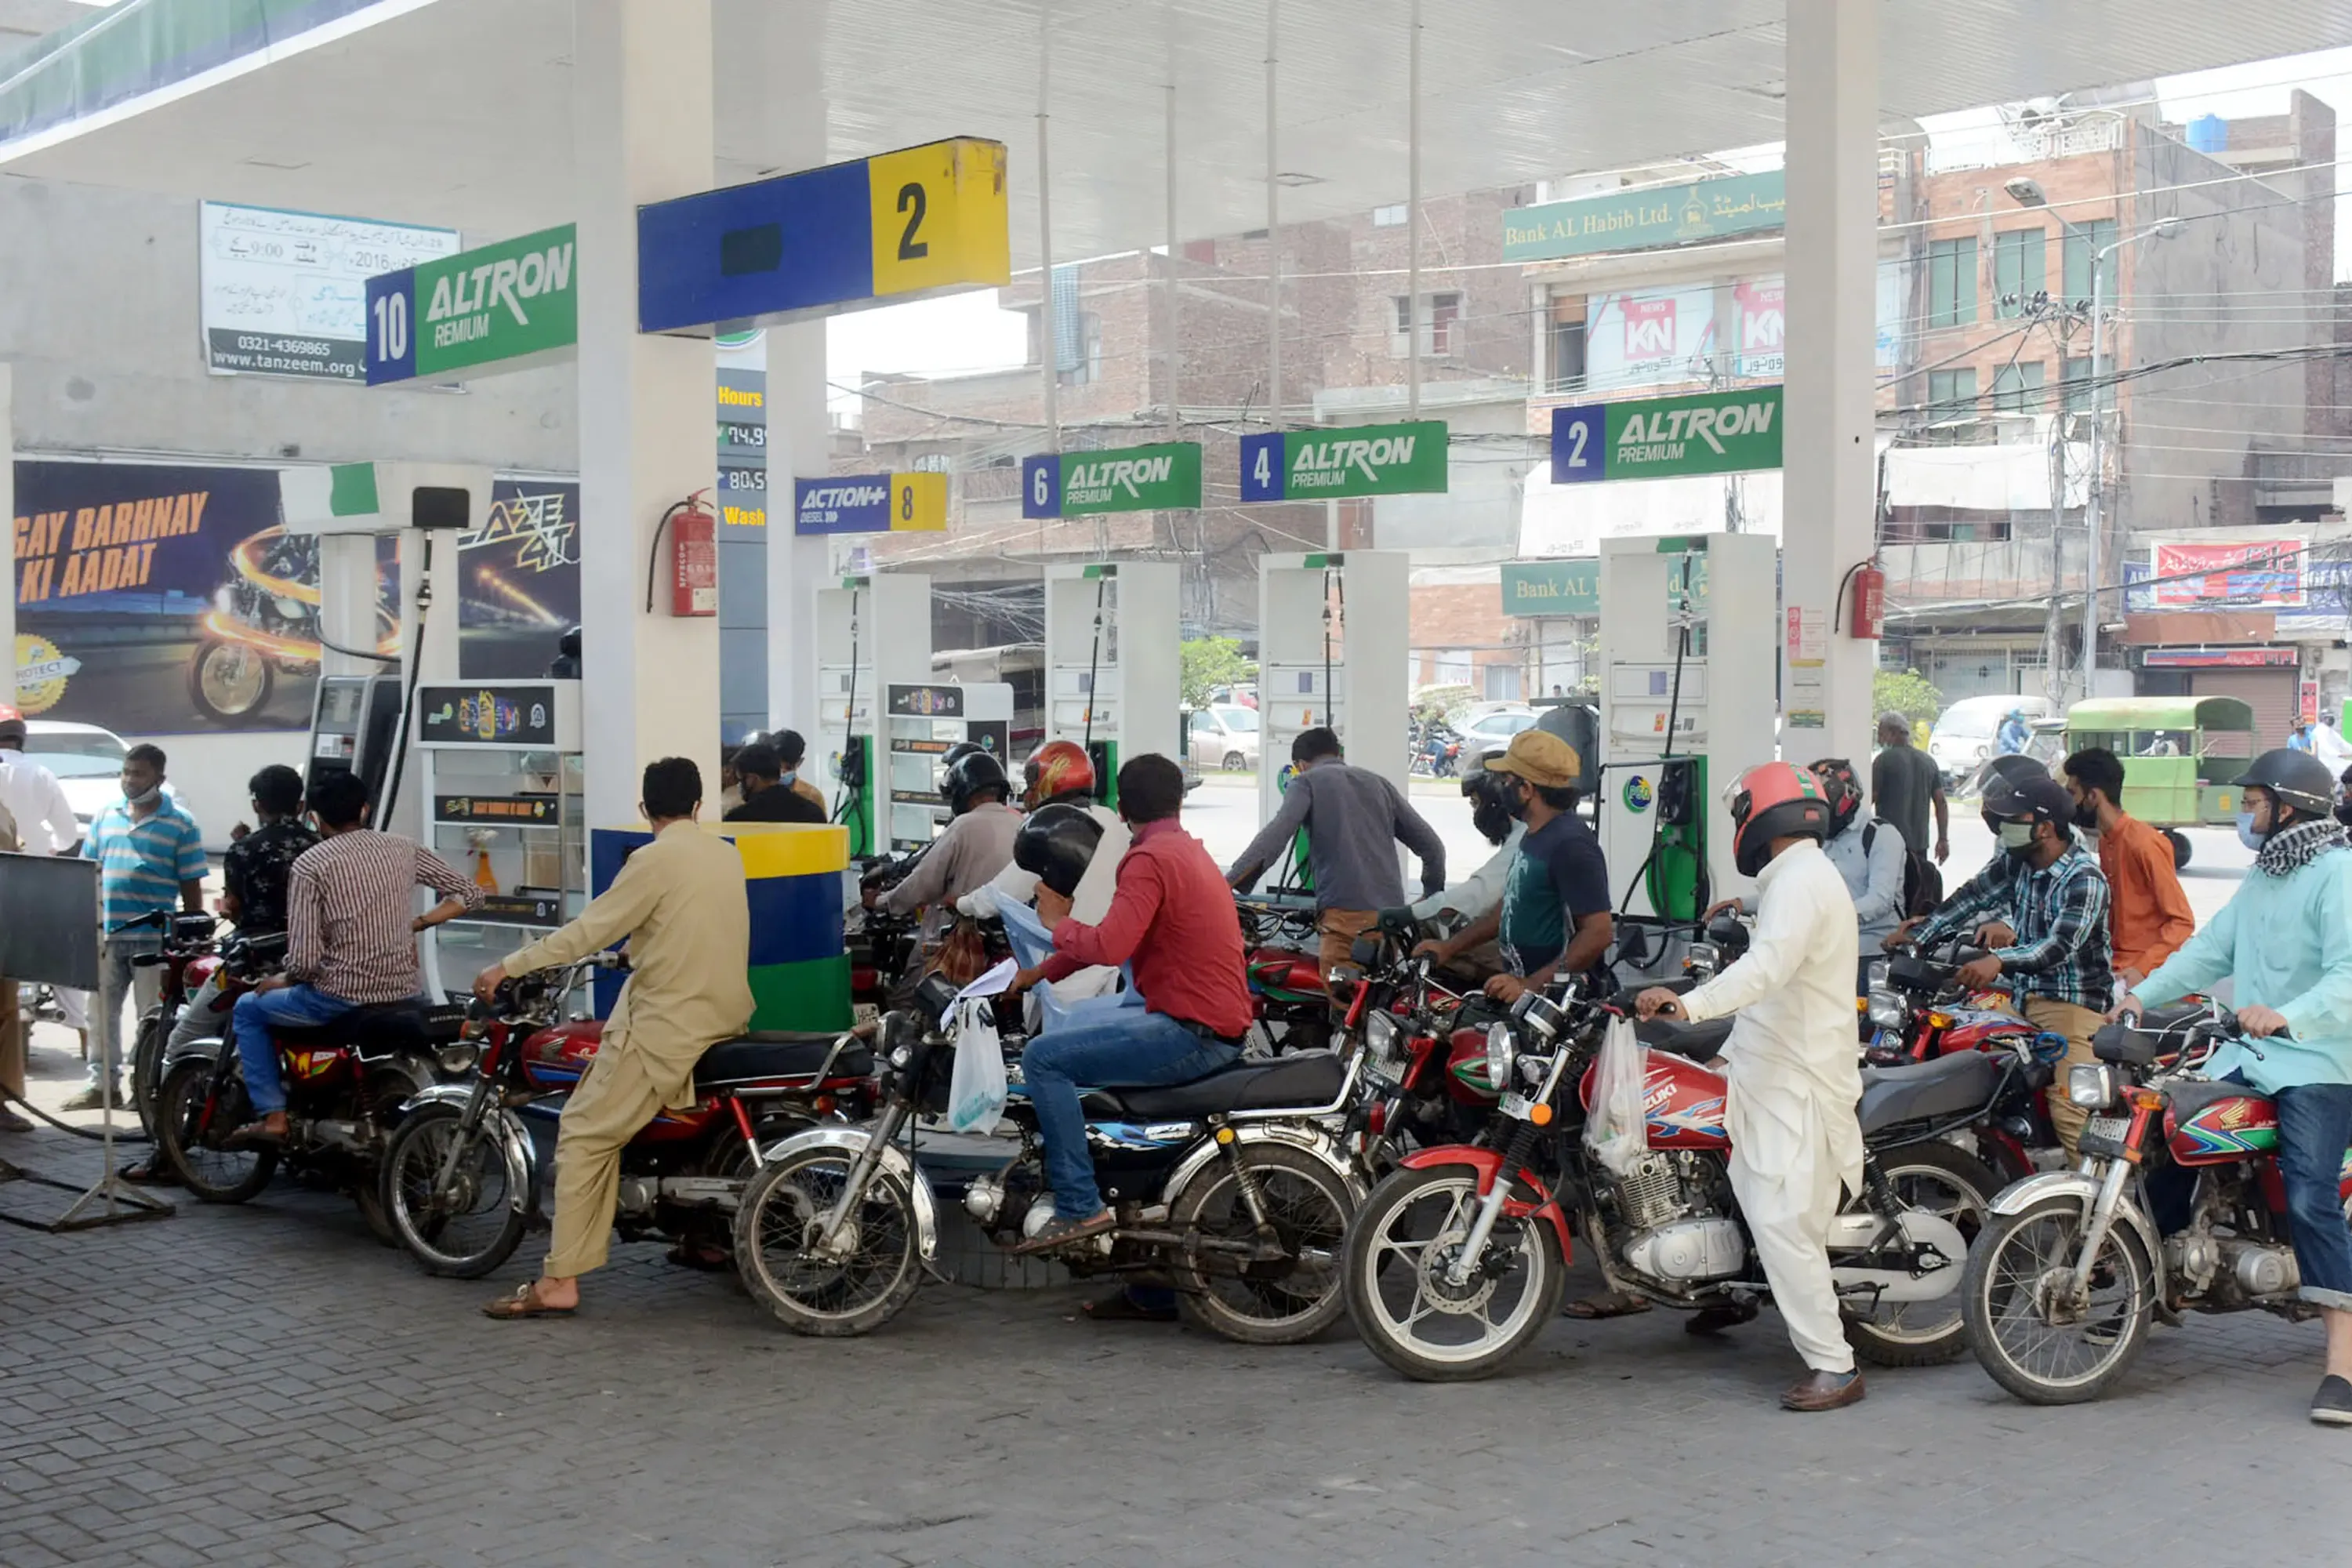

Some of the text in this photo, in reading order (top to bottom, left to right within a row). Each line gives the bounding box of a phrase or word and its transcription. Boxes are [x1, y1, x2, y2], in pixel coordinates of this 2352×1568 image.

[896, 182, 927, 261] 2
[1505, 204, 1673, 246] Bank AL Habib Ltd.
[426, 242, 573, 326] ALTRON
[1760, 290, 1784, 303] NEW
[1640, 301, 1666, 314] NEWS
[374, 292, 407, 362] 10
[434, 313, 489, 348] REMIUM
[1627, 317, 1672, 354] KN
[212, 351, 356, 377] www.tanzeem.org
[717, 386, 763, 408] Hours
[728, 426, 768, 446] 74.9
[1567, 421, 1589, 468] 2
[1617, 402, 1775, 455] ALTRON
[1254, 447, 1271, 489] 4
[1291, 436, 1416, 481] ALTRON
[1617, 443, 1685, 464] PREMIUM
[729, 470, 768, 490] 80.5
[1033, 466, 1048, 506] 6
[1065, 456, 1173, 499] ALTRON
[1292, 470, 1345, 489] PREMIUM
[801, 485, 887, 509] ACTION+
[902, 485, 913, 521] 8
[1066, 488, 1112, 506] PREMIUM
[71, 491, 210, 551] BARHNAY
[723, 506, 766, 526] Wash
[19, 542, 158, 604] KI AADAT
[1516, 579, 1559, 598] Bank
[1563, 579, 1589, 597] AL
[16, 661, 62, 680] ROTECT
[1643, 1083, 1678, 1109] ZUKI
